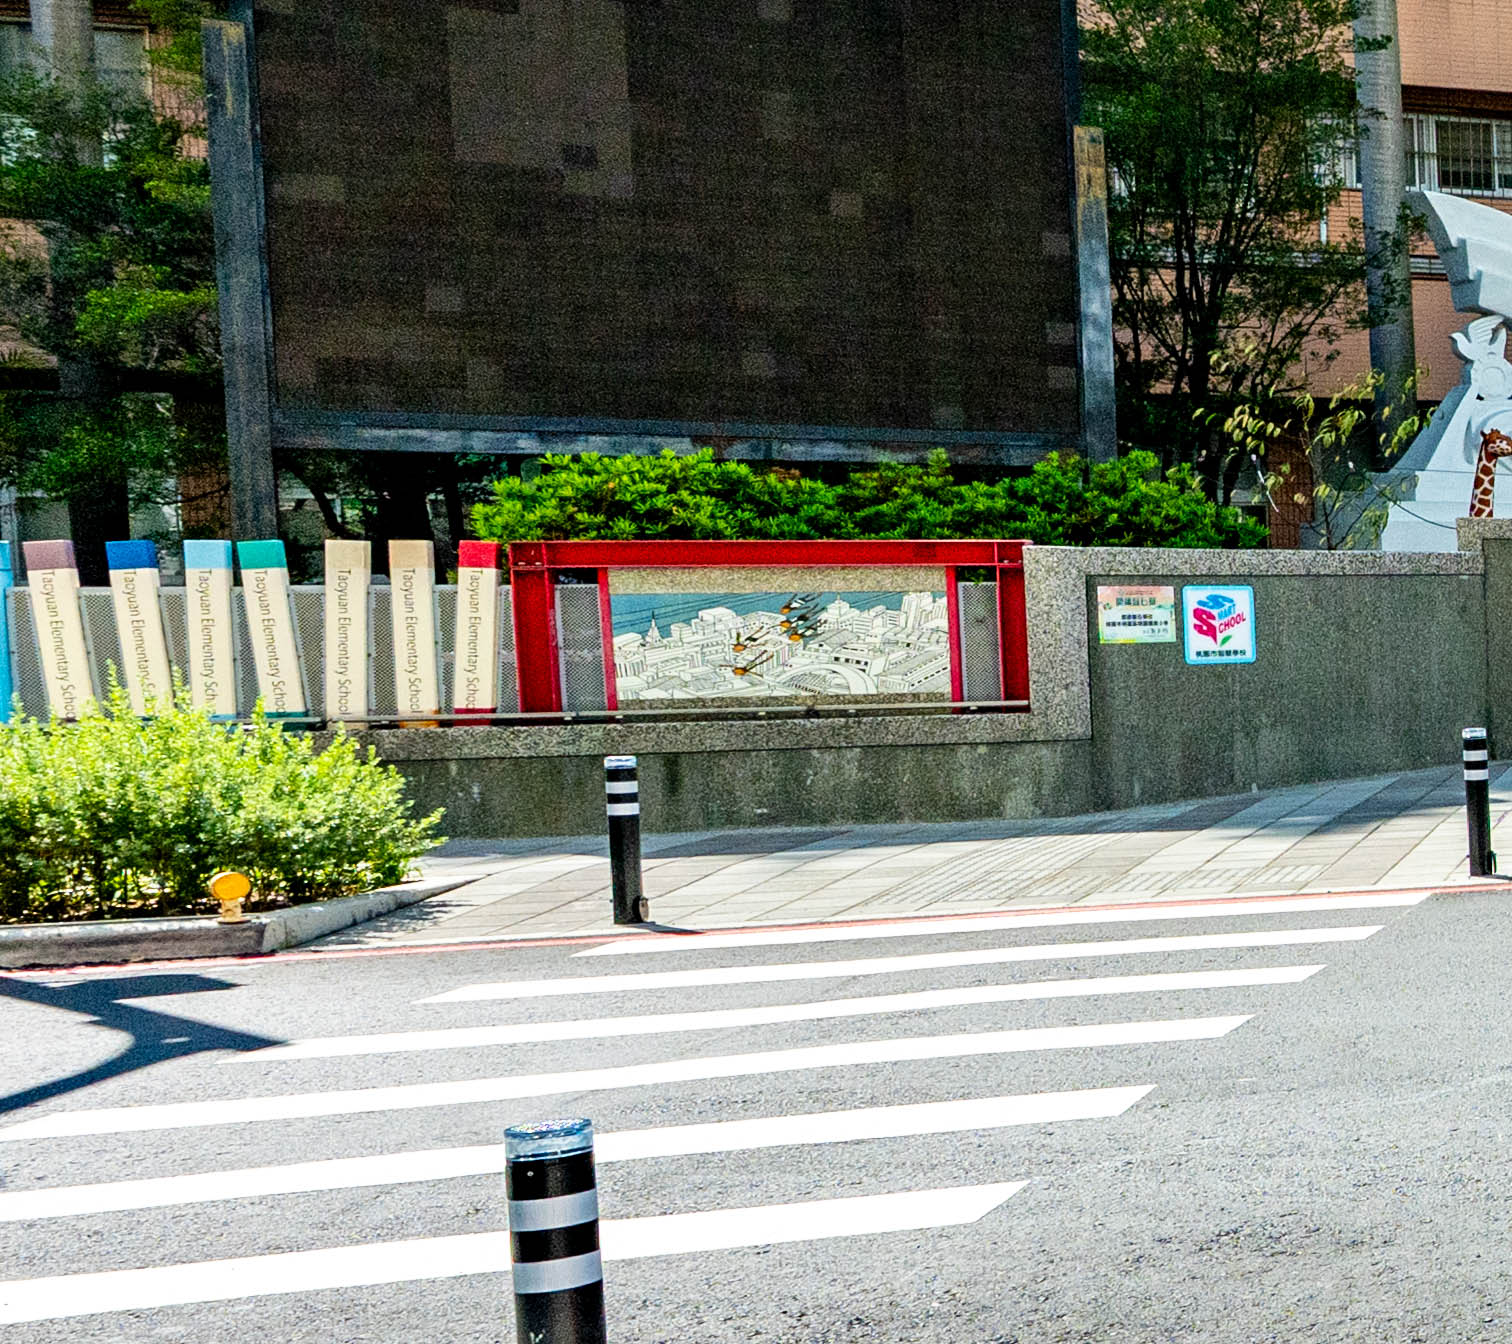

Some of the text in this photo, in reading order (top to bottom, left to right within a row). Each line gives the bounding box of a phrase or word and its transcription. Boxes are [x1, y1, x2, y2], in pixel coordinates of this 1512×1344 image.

[41, 571, 77, 719] Taoyuan Elementary Schoo
[122, 571, 141, 616] Taoyuan
[195, 570, 219, 701] Taoyuan Elementary Sch
[254, 570, 286, 713] Taoyuan Elementary Schoo
[333, 570, 353, 716] Taoyuan Elementary School
[400, 569, 424, 713] Taoyuan Elementary School
[463, 570, 483, 708] Taoyuan Elementary Schoo
